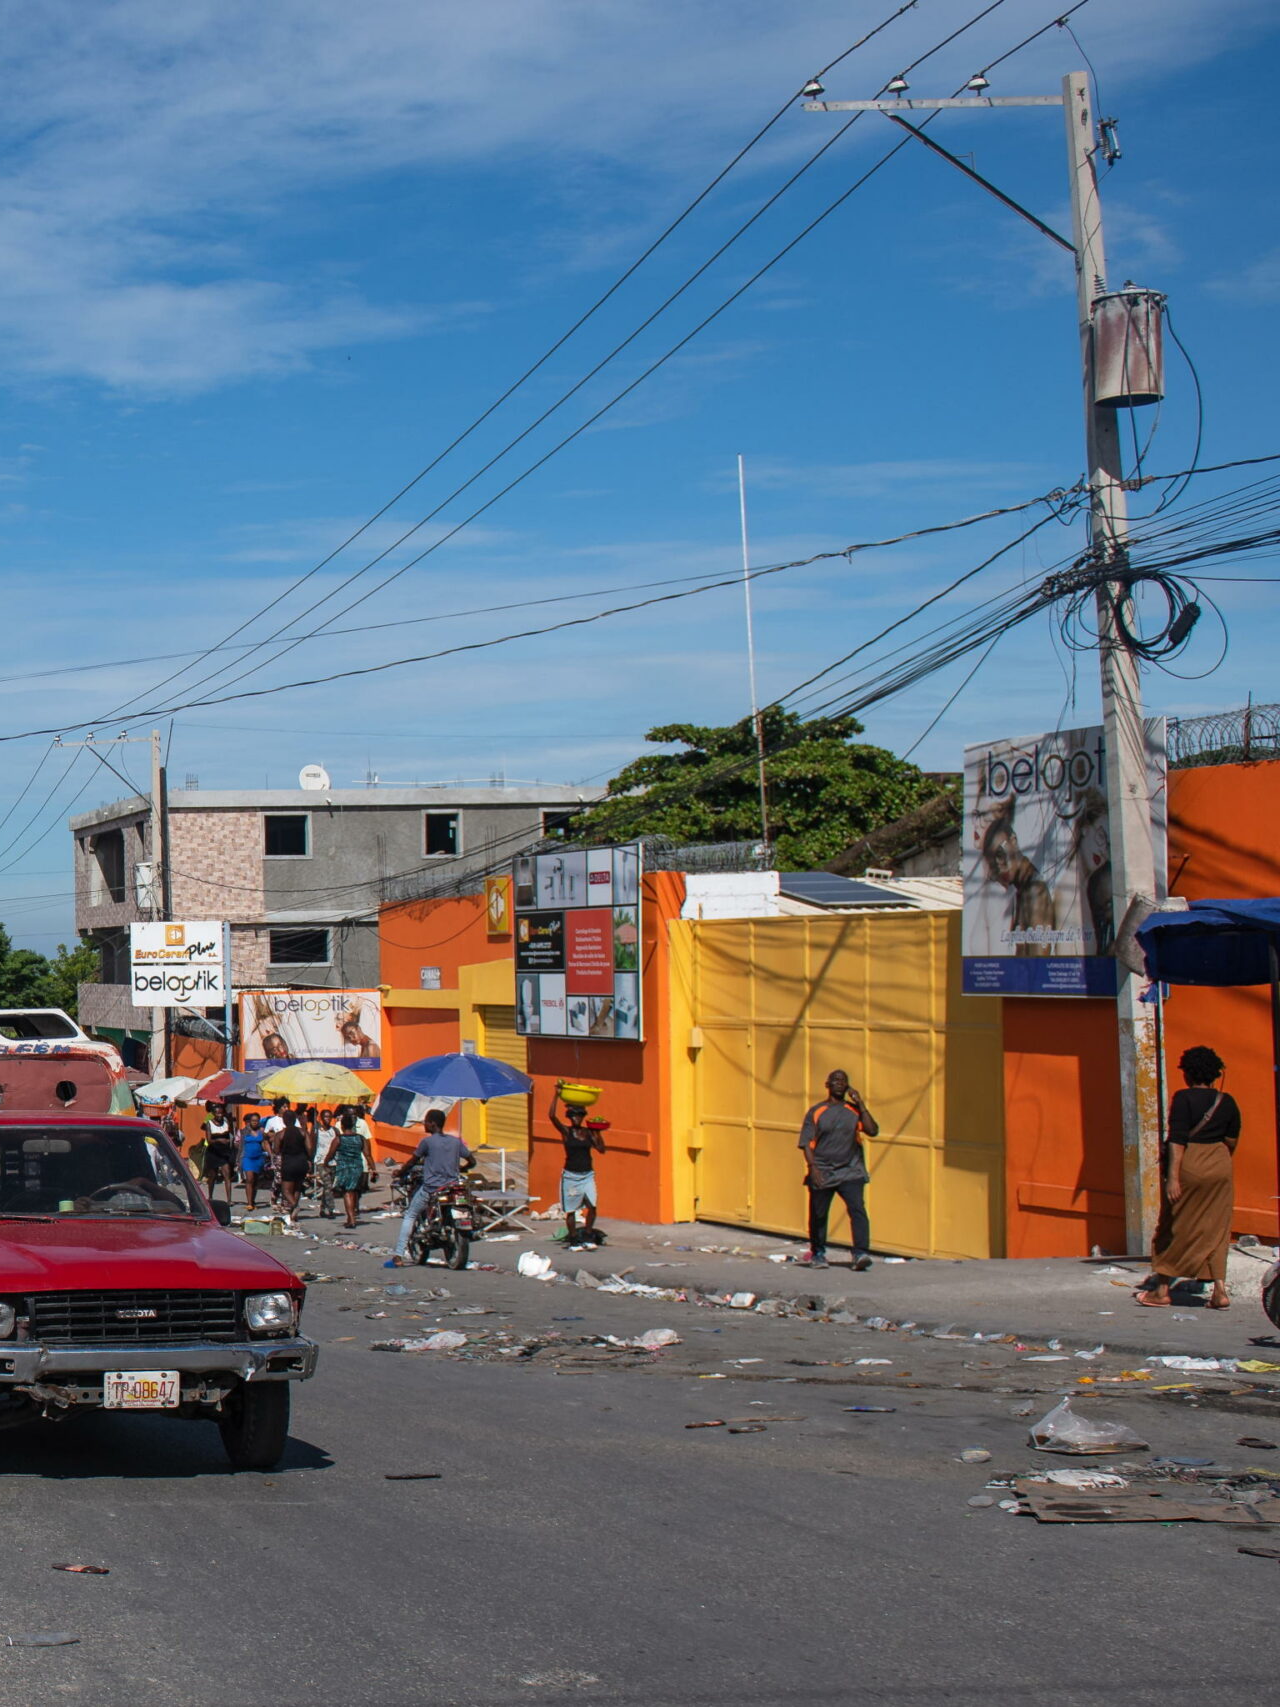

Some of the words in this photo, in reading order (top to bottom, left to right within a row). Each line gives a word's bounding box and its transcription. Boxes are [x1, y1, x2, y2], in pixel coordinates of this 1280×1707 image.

[987, 733, 1106, 802] belopt
[135, 971, 218, 996] beloptik
[274, 996, 350, 1015] beloptik
[119, 1309, 157, 1318] TOYOTA
